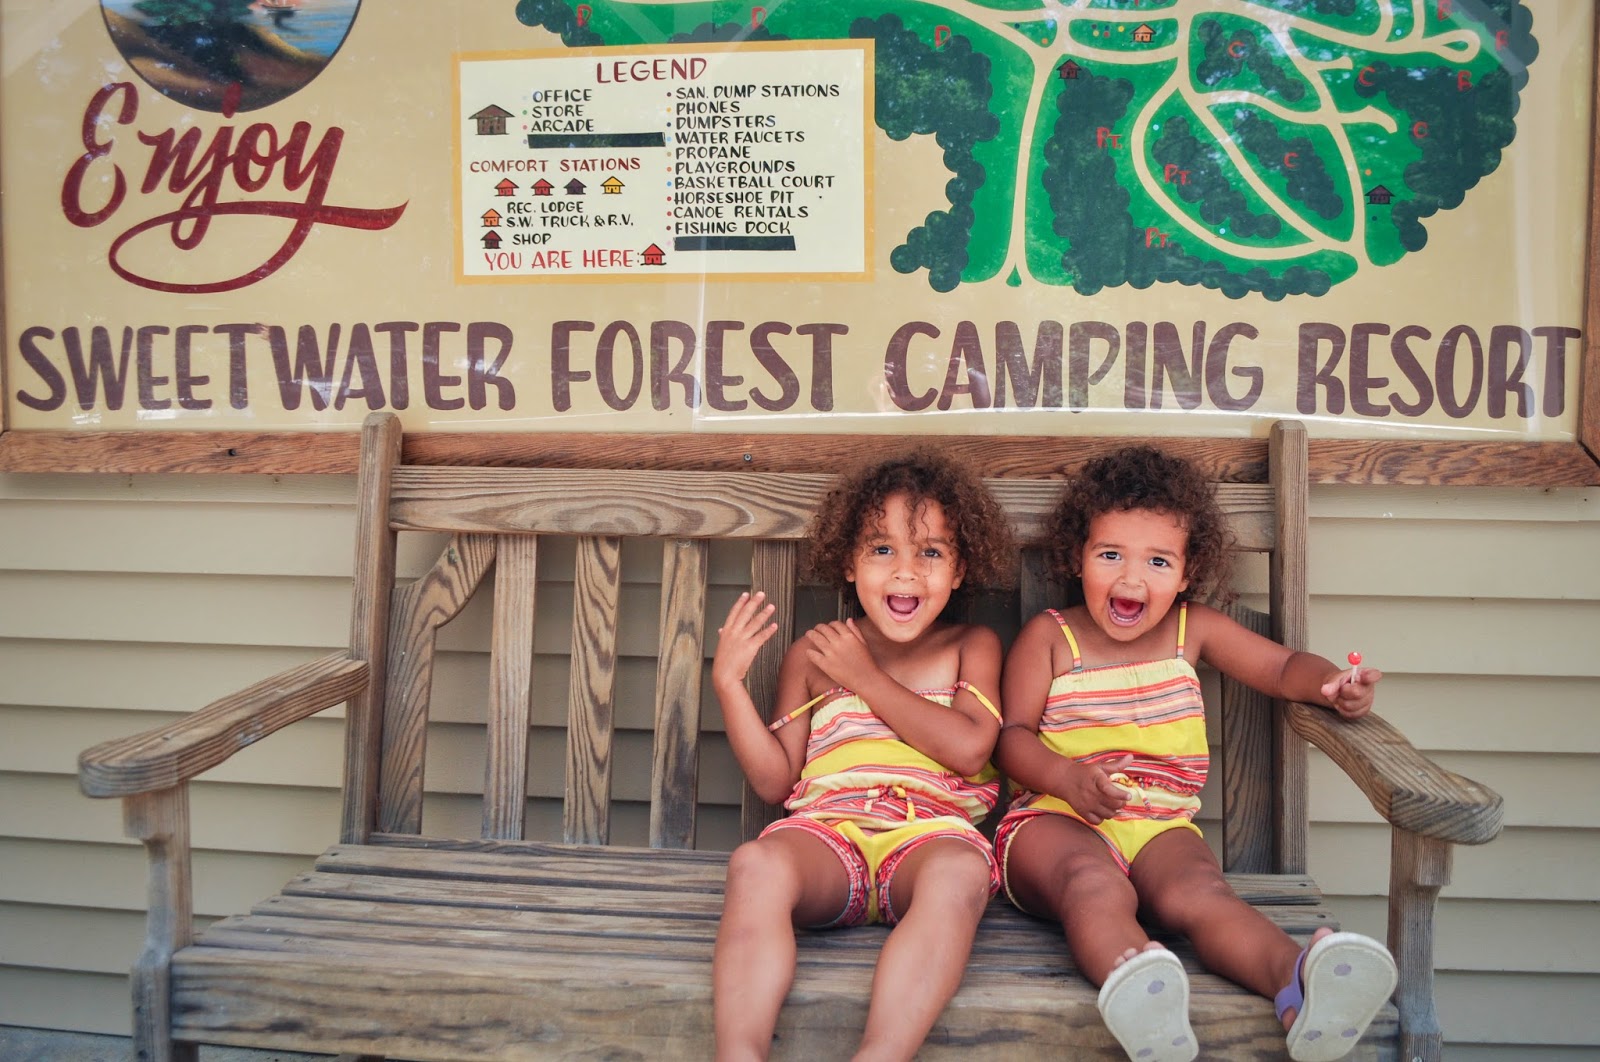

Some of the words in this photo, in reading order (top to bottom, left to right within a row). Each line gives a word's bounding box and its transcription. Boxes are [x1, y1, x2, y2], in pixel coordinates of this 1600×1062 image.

[935, 25, 951, 48] D
[1228, 40, 1244, 58] C
[597, 58, 706, 83] LEGEND
[1359, 66, 1375, 86] C
[533, 89, 592, 103] OFFICE
[676, 87, 708, 99] SAN.
[714, 85, 756, 98] DUMP
[762, 84, 839, 97] STATIONS
[532, 105, 584, 117] STORE
[677, 101, 740, 114] PHONES
[531, 119, 593, 132] ARCADE
[676, 115, 775, 129] DUMPSTERS
[1413, 121, 1428, 138] C
[675, 132, 728, 144] WATER
[735, 131, 804, 143] FAUCETS
[676, 146, 750, 159] PROPANE
[470, 160, 548, 172] COMFORT
[560, 158, 640, 172] STATIONS
[676, 160, 795, 173] PLAYGROUNDS
[1283, 152, 1298, 168] C
[62, 82, 409, 293] Enjoy
[675, 176, 774, 189] BASKETBALL
[781, 175, 835, 188] COURT
[674, 192, 762, 204] HORSESHOE
[771, 191, 794, 203] PIT
[507, 202, 536, 214] REC.
[541, 201, 583, 213] LODGE
[674, 206, 723, 218] CANOE
[735, 205, 808, 218] RENTALS
[507, 216, 533, 227] S.W.
[540, 215, 589, 227] TRUCK
[675, 221, 737, 234] FISHING
[745, 221, 790, 234] DOCK
[512, 233, 551, 245] SHOP
[485, 252, 521, 270] YOU
[532, 251, 572, 268] ARE
[17, 322, 515, 411] SWEETWATER
[552, 321, 848, 411] FOREST
[885, 321, 1263, 411] CAMPING
[1296, 322, 1581, 418] RESORT
